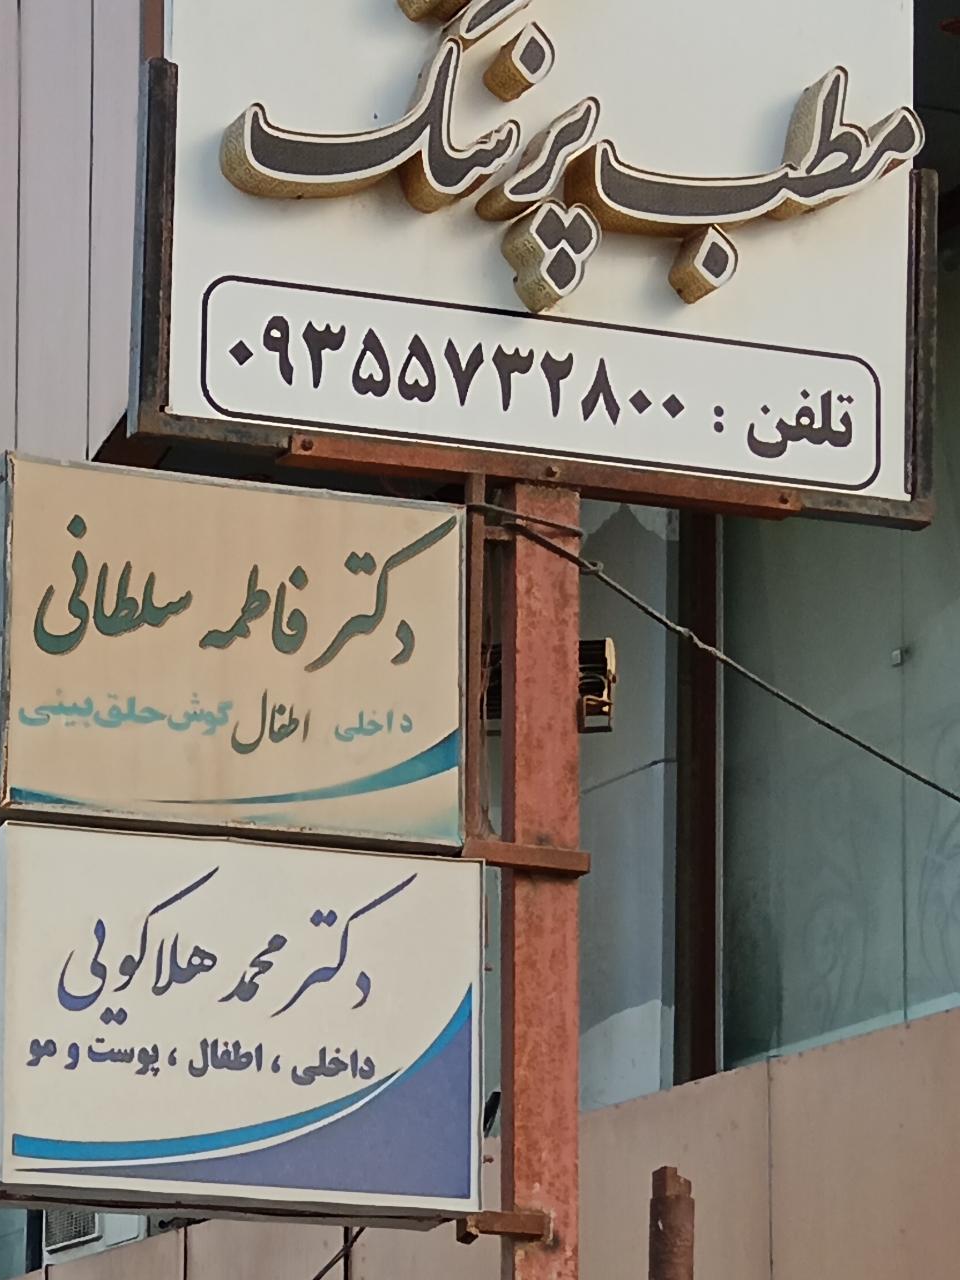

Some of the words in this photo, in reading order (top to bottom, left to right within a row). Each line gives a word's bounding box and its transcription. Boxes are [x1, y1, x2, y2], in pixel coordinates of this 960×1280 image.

[593, 64, 924, 287] مطب
[227, 313, 685, 427] ۰۹۳۵۵۷۳۲۸۰۰
[33, 514, 193, 655] سلطانی
[198, 564, 309, 655] فاطمه
[305, 515, 458, 672] دکتر
[18, 688, 92, 730] بینی
[92, 691, 167, 730] حلق
[230, 689, 310, 755] اطفال
[333, 708, 414, 743] داخلی
[217, 932, 288, 1003] محمد
[270, 872, 418, 1018] دکتر
[25, 1037, 58, 1068] مو
[64, 1042, 80, 1070] و
[86, 1037, 161, 1078] پوست
